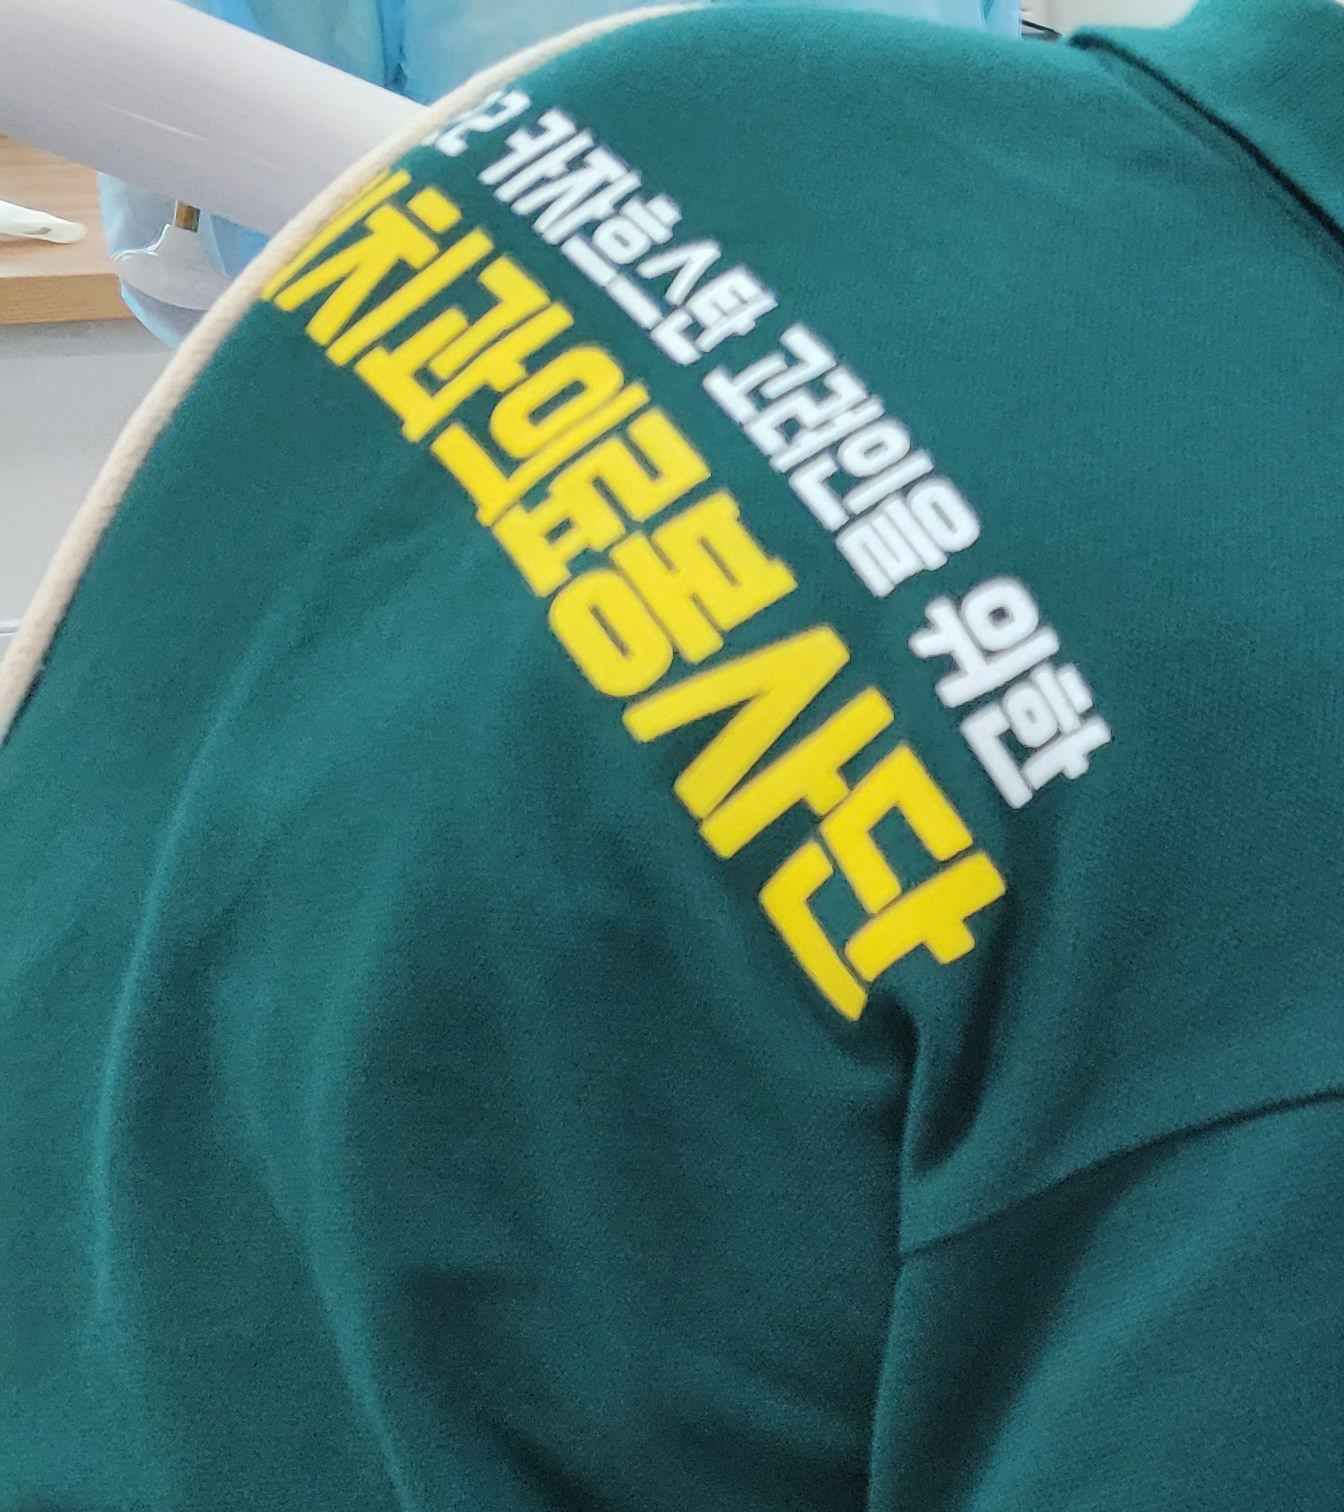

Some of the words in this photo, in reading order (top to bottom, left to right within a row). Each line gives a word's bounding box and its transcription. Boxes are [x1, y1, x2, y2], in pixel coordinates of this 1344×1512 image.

[262, 172, 1006, 1021] 치과의료봉사단
[478, 108, 777, 367] 카자흐스탄
[702, 324, 981, 598] 고려인을
[908, 576, 1112, 809] 위한
